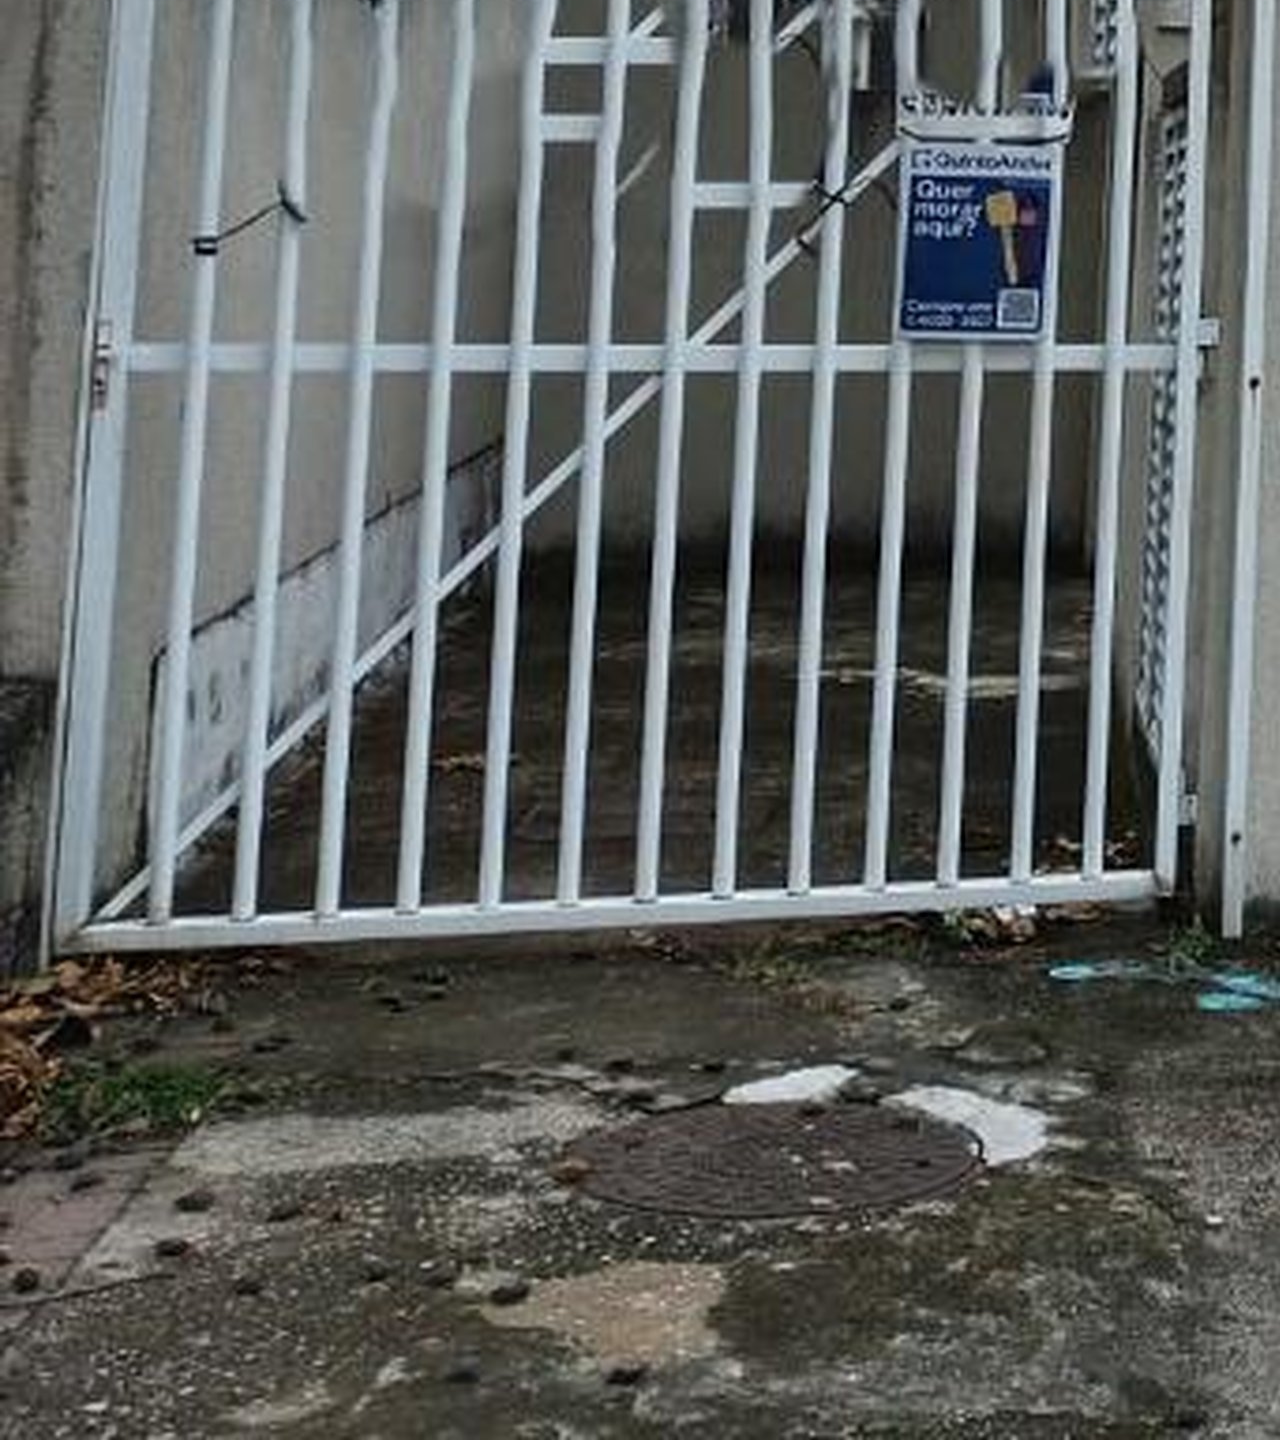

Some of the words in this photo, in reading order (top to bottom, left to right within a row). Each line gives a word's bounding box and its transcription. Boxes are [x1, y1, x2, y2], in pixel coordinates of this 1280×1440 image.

[916, 179, 974, 199] Quer
[914, 202, 982, 219] morar
[913, 217, 978, 239] aqui?
